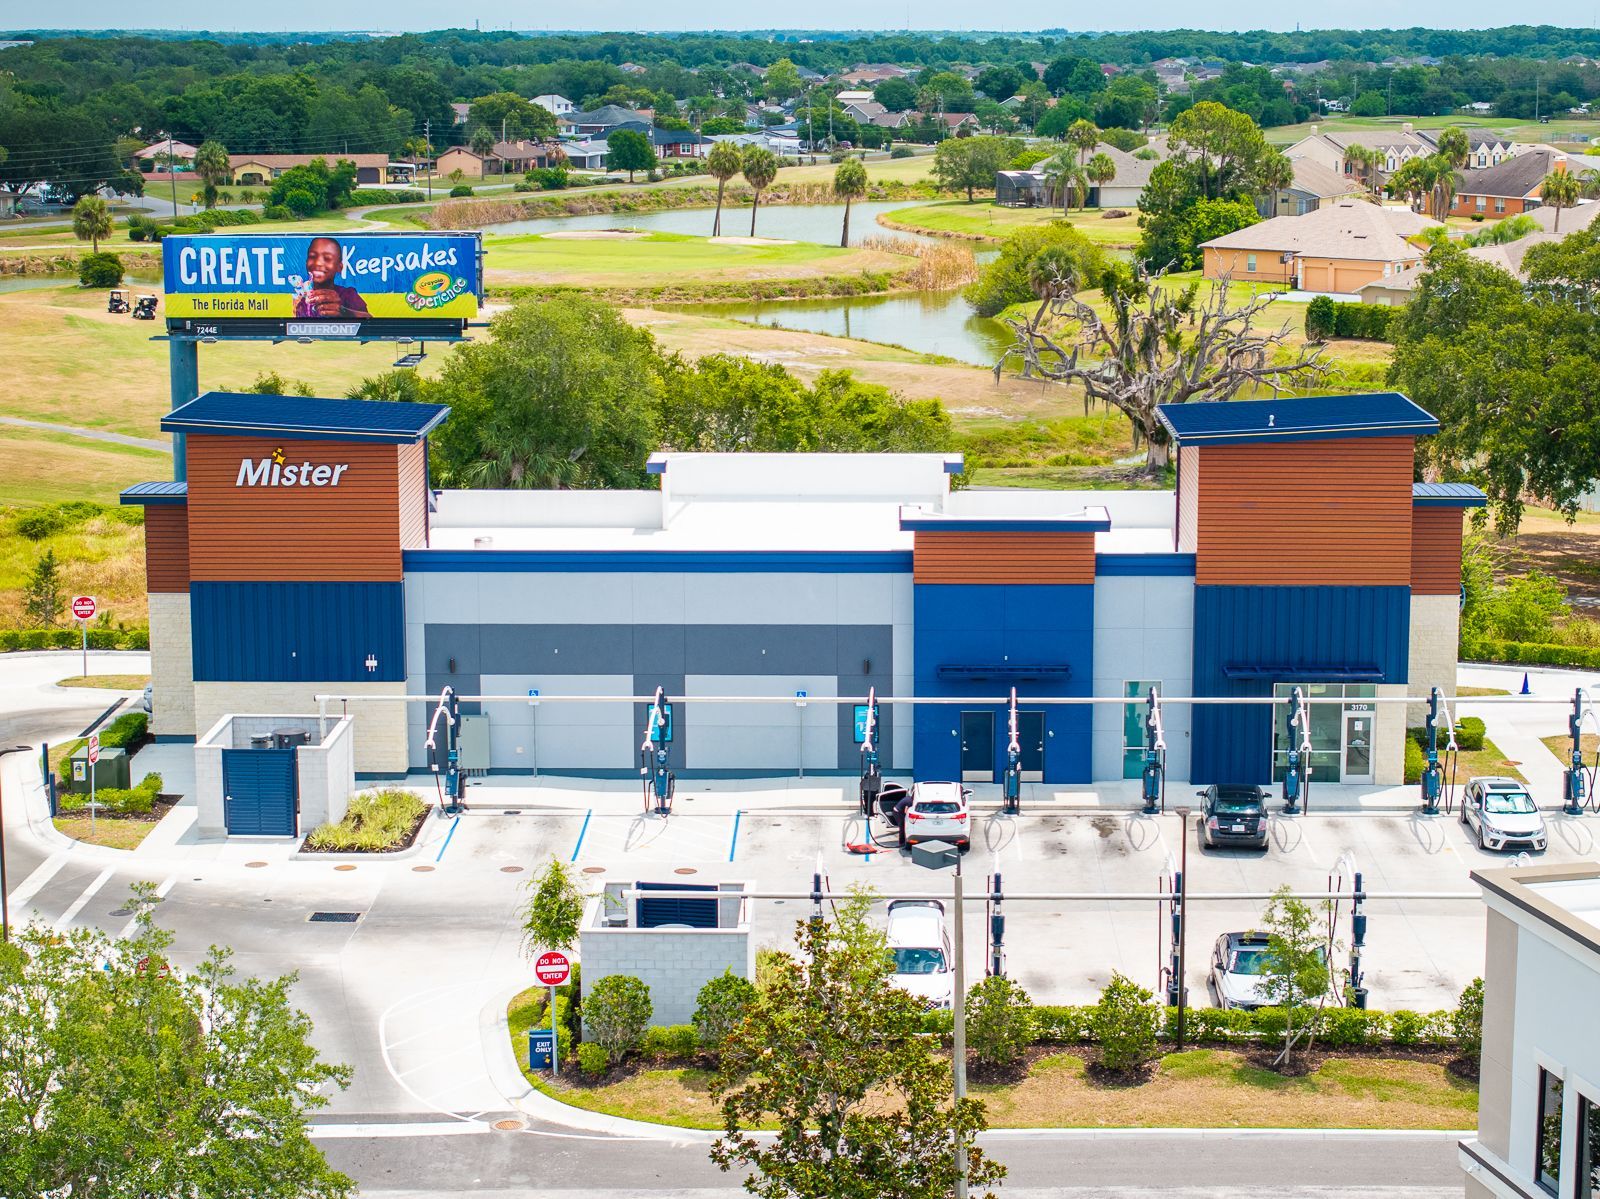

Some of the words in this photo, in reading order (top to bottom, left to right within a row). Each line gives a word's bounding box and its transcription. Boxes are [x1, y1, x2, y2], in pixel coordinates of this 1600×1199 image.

[180, 247, 286, 285] CREATE
[341, 243, 458, 282] Keepsakes
[192, 298, 209, 310] The
[212, 299, 244, 311] Florida
[248, 299, 269, 311] Mall
[196, 326, 218, 335] 7244E
[289, 325, 354, 335] OUTFRONT
[235, 458, 349, 487] Mister
